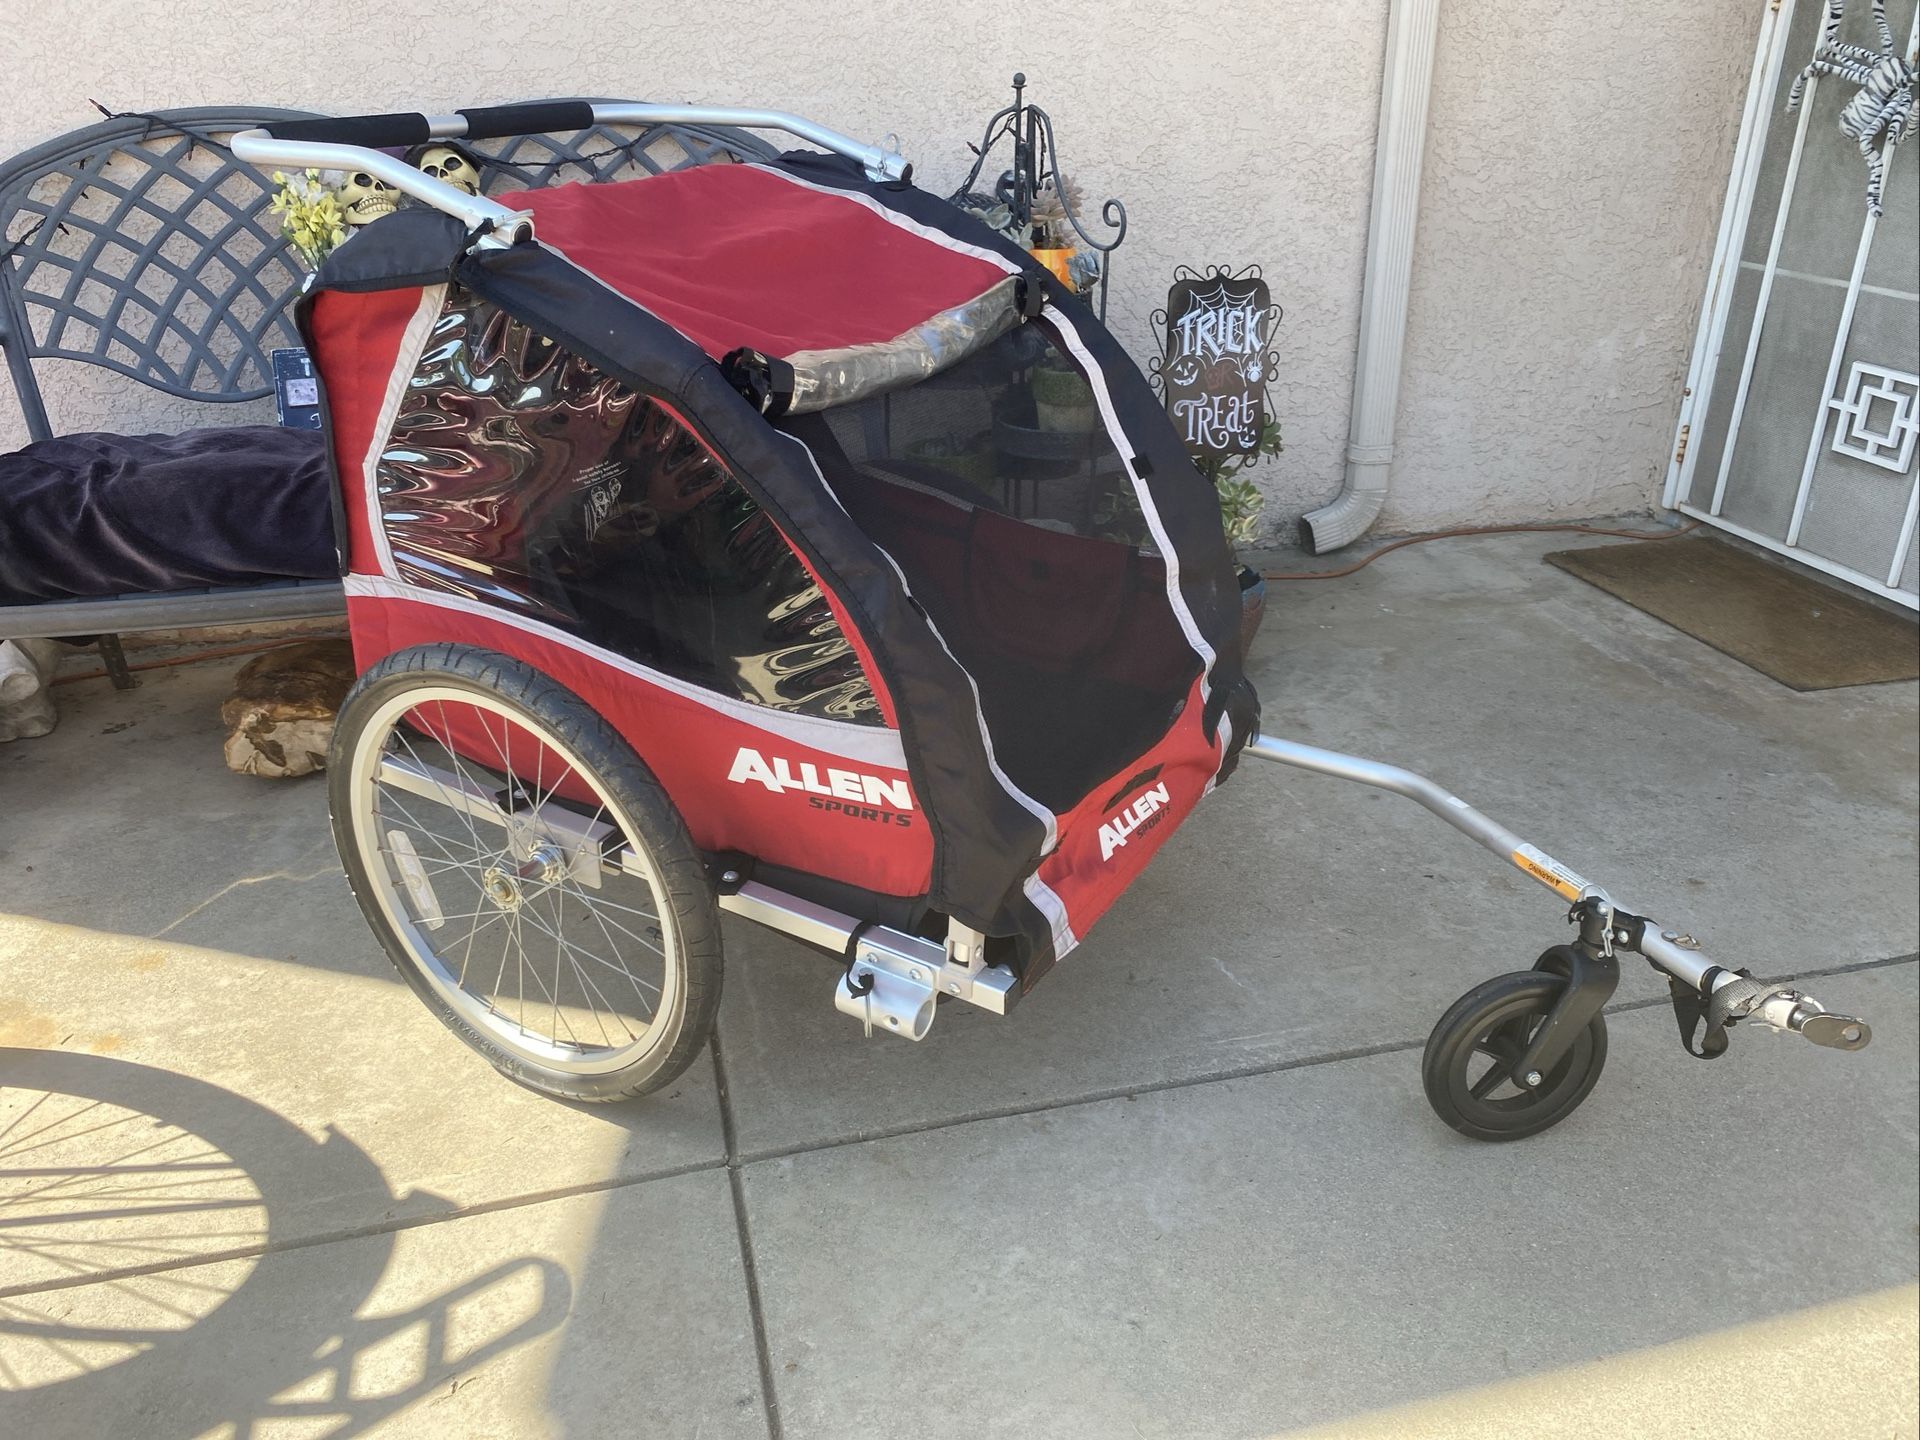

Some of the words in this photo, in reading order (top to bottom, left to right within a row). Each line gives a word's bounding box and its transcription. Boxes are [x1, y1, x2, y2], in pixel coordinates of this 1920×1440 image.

[1177, 305, 1265, 356] TRICK
[728, 747, 914, 811] ALLEN
[808, 796, 912, 827] SPORTS
[1098, 781, 1171, 862] ALLEN
